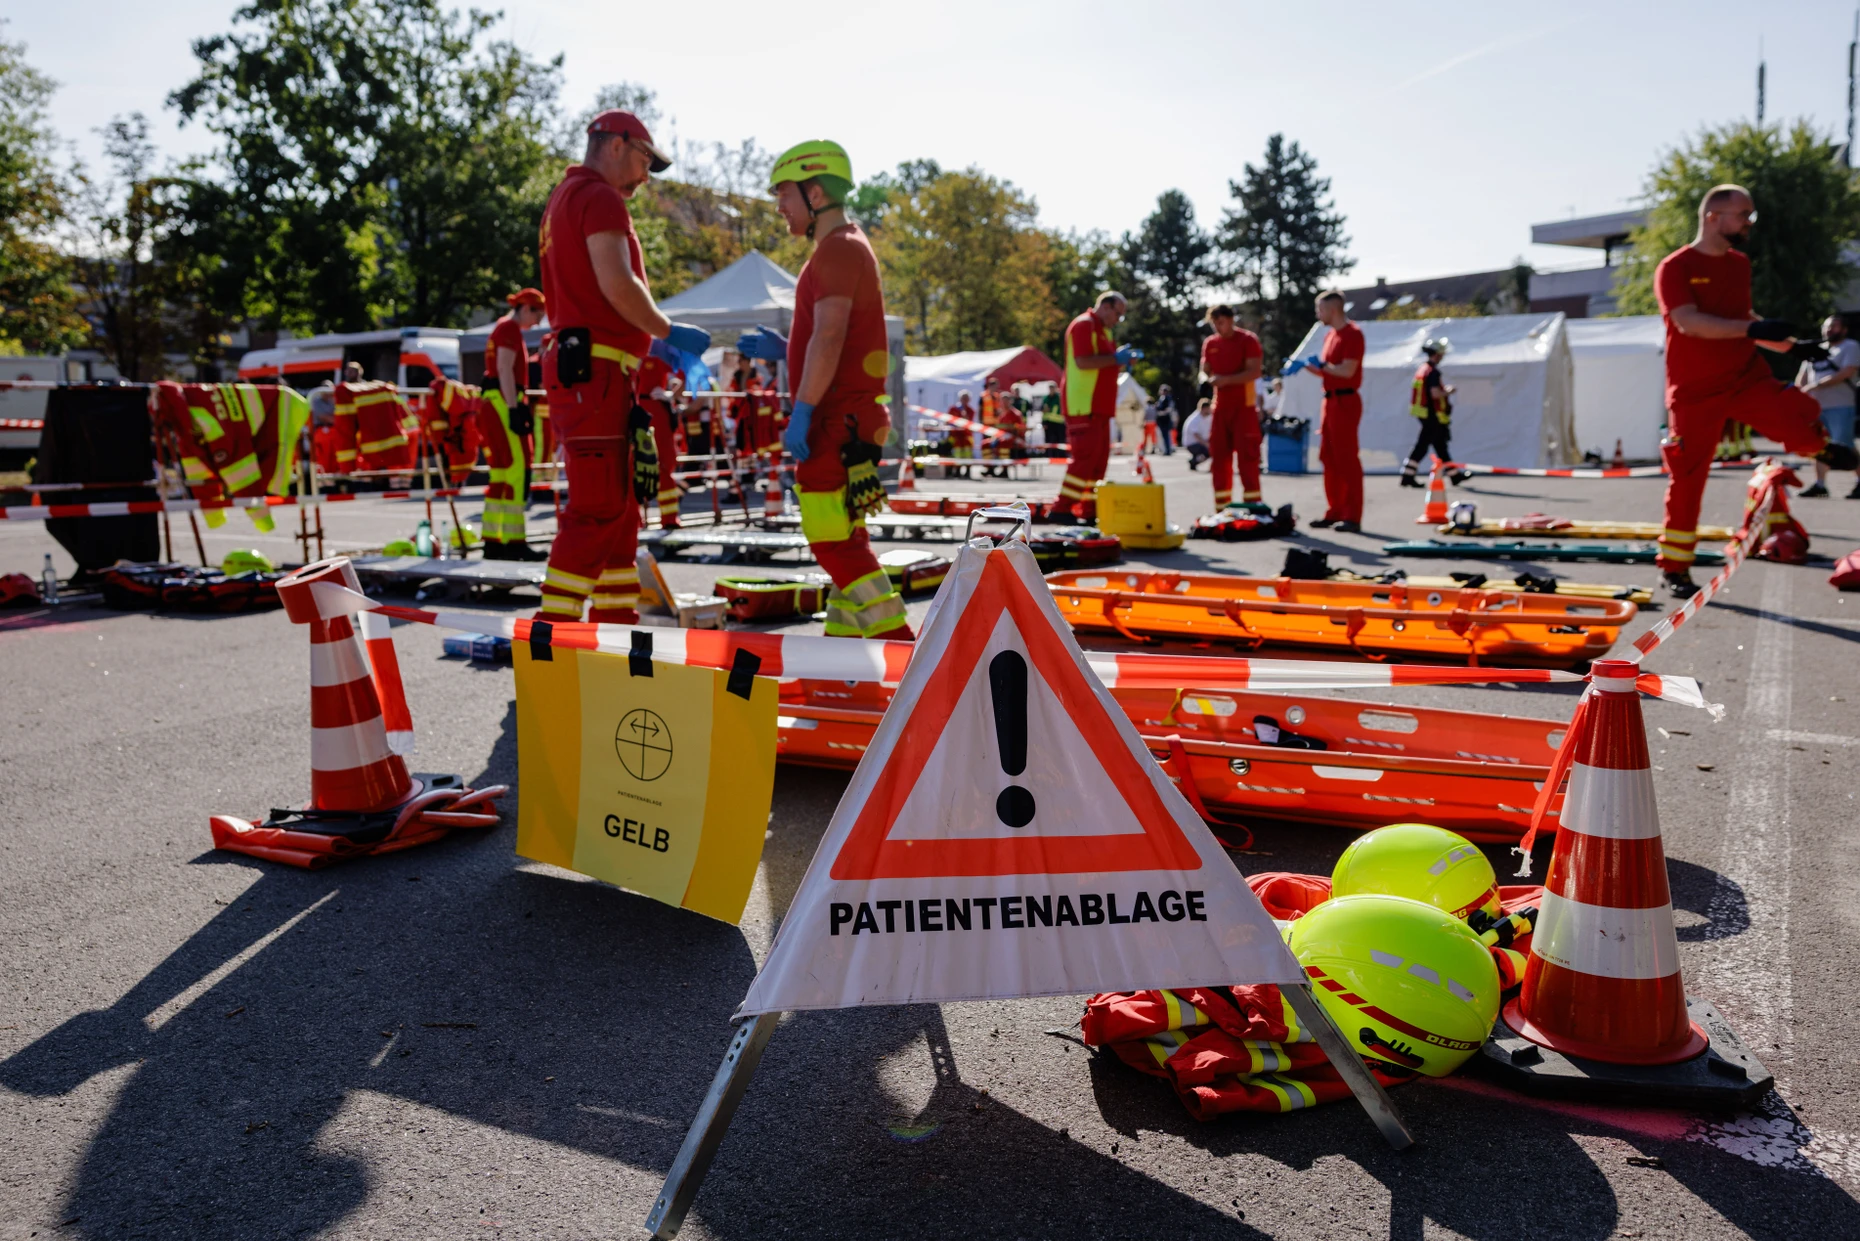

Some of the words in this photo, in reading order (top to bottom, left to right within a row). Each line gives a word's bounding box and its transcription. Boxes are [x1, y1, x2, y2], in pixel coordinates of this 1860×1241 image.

[604, 813, 670, 853] GELB
[830, 890, 1208, 936] PATIENTENABLAGE
[1425, 1034, 1471, 1049] DLRG
